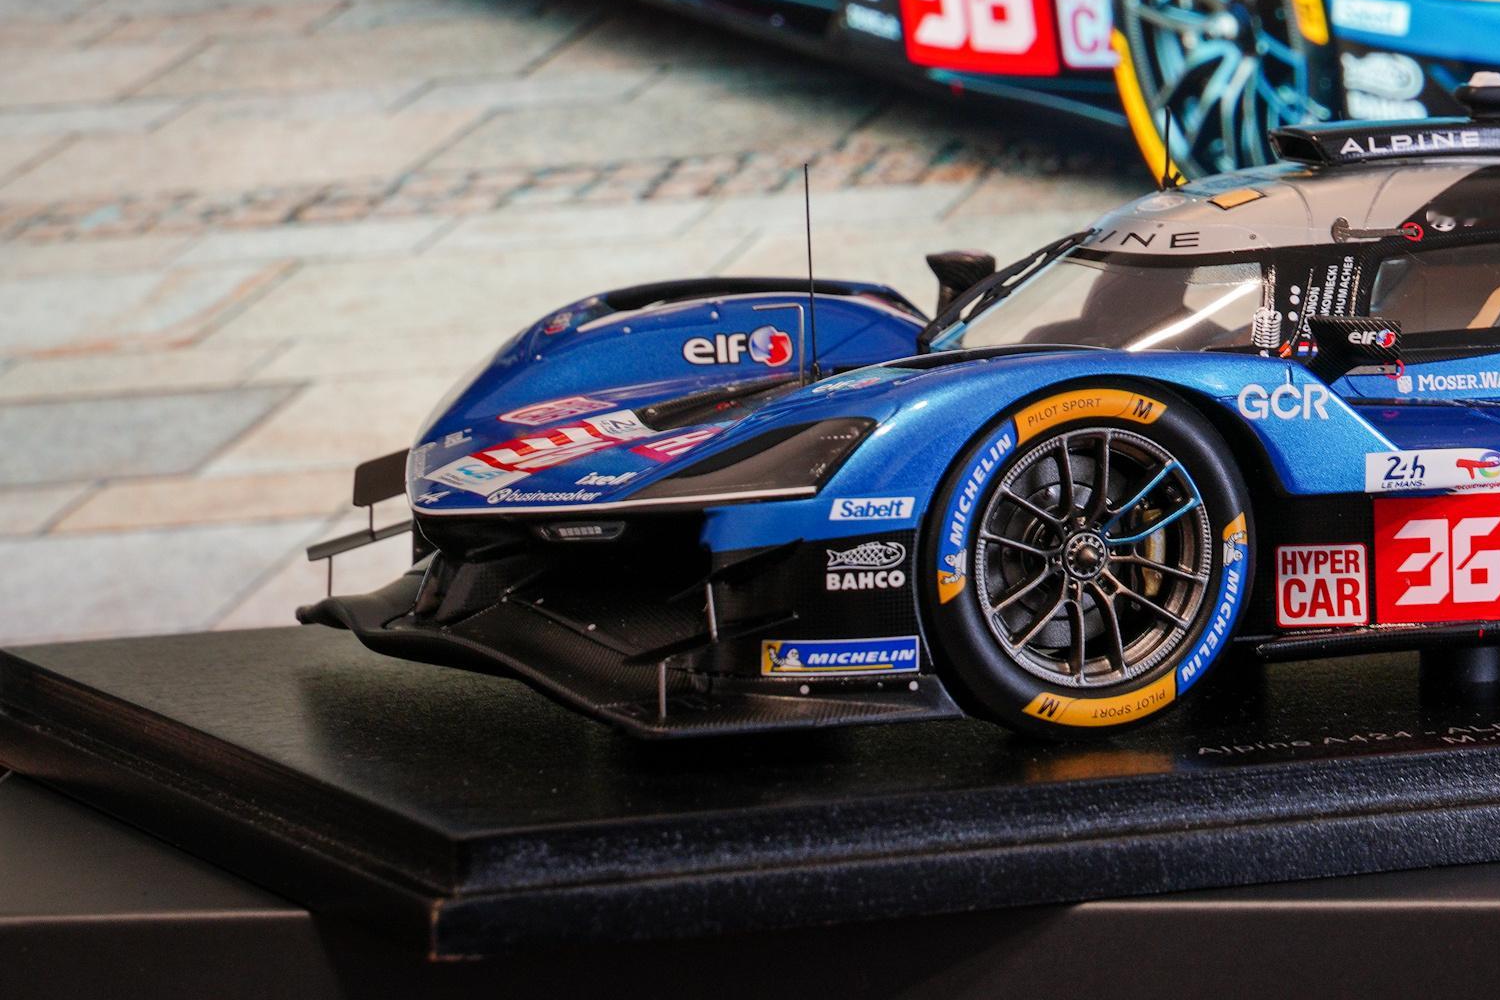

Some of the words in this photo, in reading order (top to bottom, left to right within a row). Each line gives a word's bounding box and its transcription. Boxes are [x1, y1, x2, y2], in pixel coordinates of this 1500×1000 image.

[1340, 130, 1481, 155] ALPINE
[1347, 330, 1377, 345] elf
[683, 332, 748, 367] elf
[1027, 404, 1060, 427] PILOT
[1062, 397, 1102, 414] SPORT
[1132, 399, 1153, 420] M
[1237, 383, 1332, 421] GCR
[575, 471, 637, 486] ixell
[949, 432, 1013, 548] MICHELIN
[1381, 480, 1393, 489] LE
[839, 499, 904, 518] Sabelt
[1281, 549, 1361, 576] HYPER
[826, 569, 907, 591] BAHCO
[1282, 576, 1363, 619] CAR
[1181, 568, 1241, 682] MICHELIN
[807, 649, 916, 665] MICHELIN
[1090, 703, 1132, 720] SPORT
[1134, 688, 1167, 712] PILOT
[1198, 739, 1312, 754] Alpine
